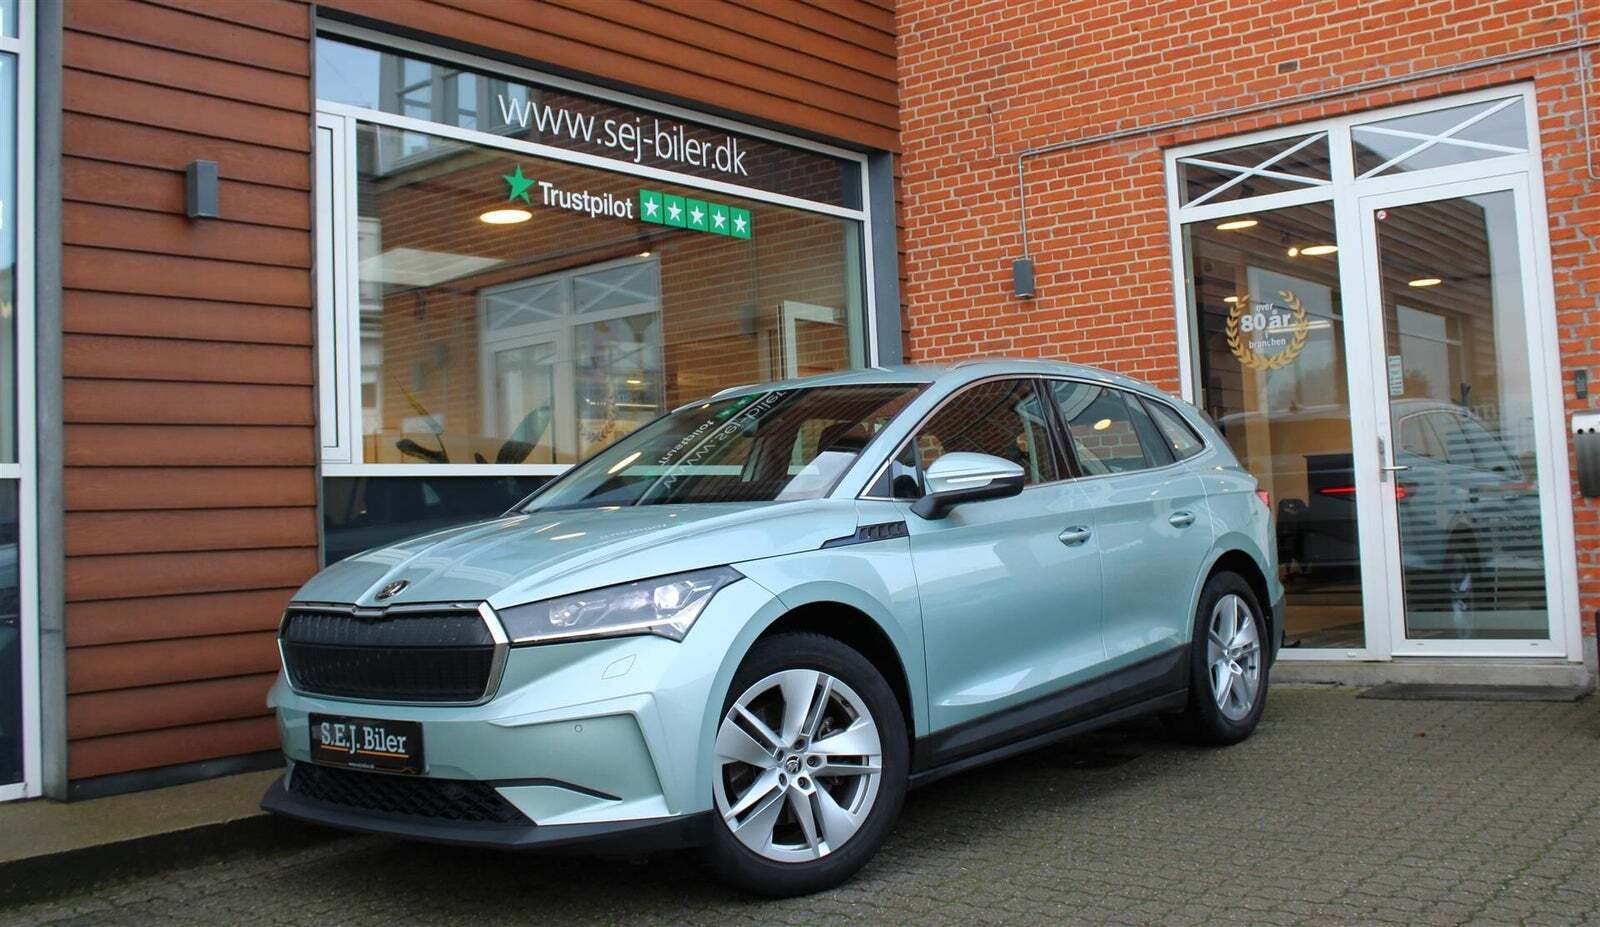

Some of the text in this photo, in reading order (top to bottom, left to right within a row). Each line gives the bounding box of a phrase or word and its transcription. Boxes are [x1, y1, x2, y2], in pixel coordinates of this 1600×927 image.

[498, 94, 748, 176] www.sej-biler.dk
[538, 180, 634, 219] Trustpilot
[1241, 309, 1291, 332] 80 år
[1248, 338, 1286, 349] branchen
[320, 722, 406, 754] S.E.J. Biler
